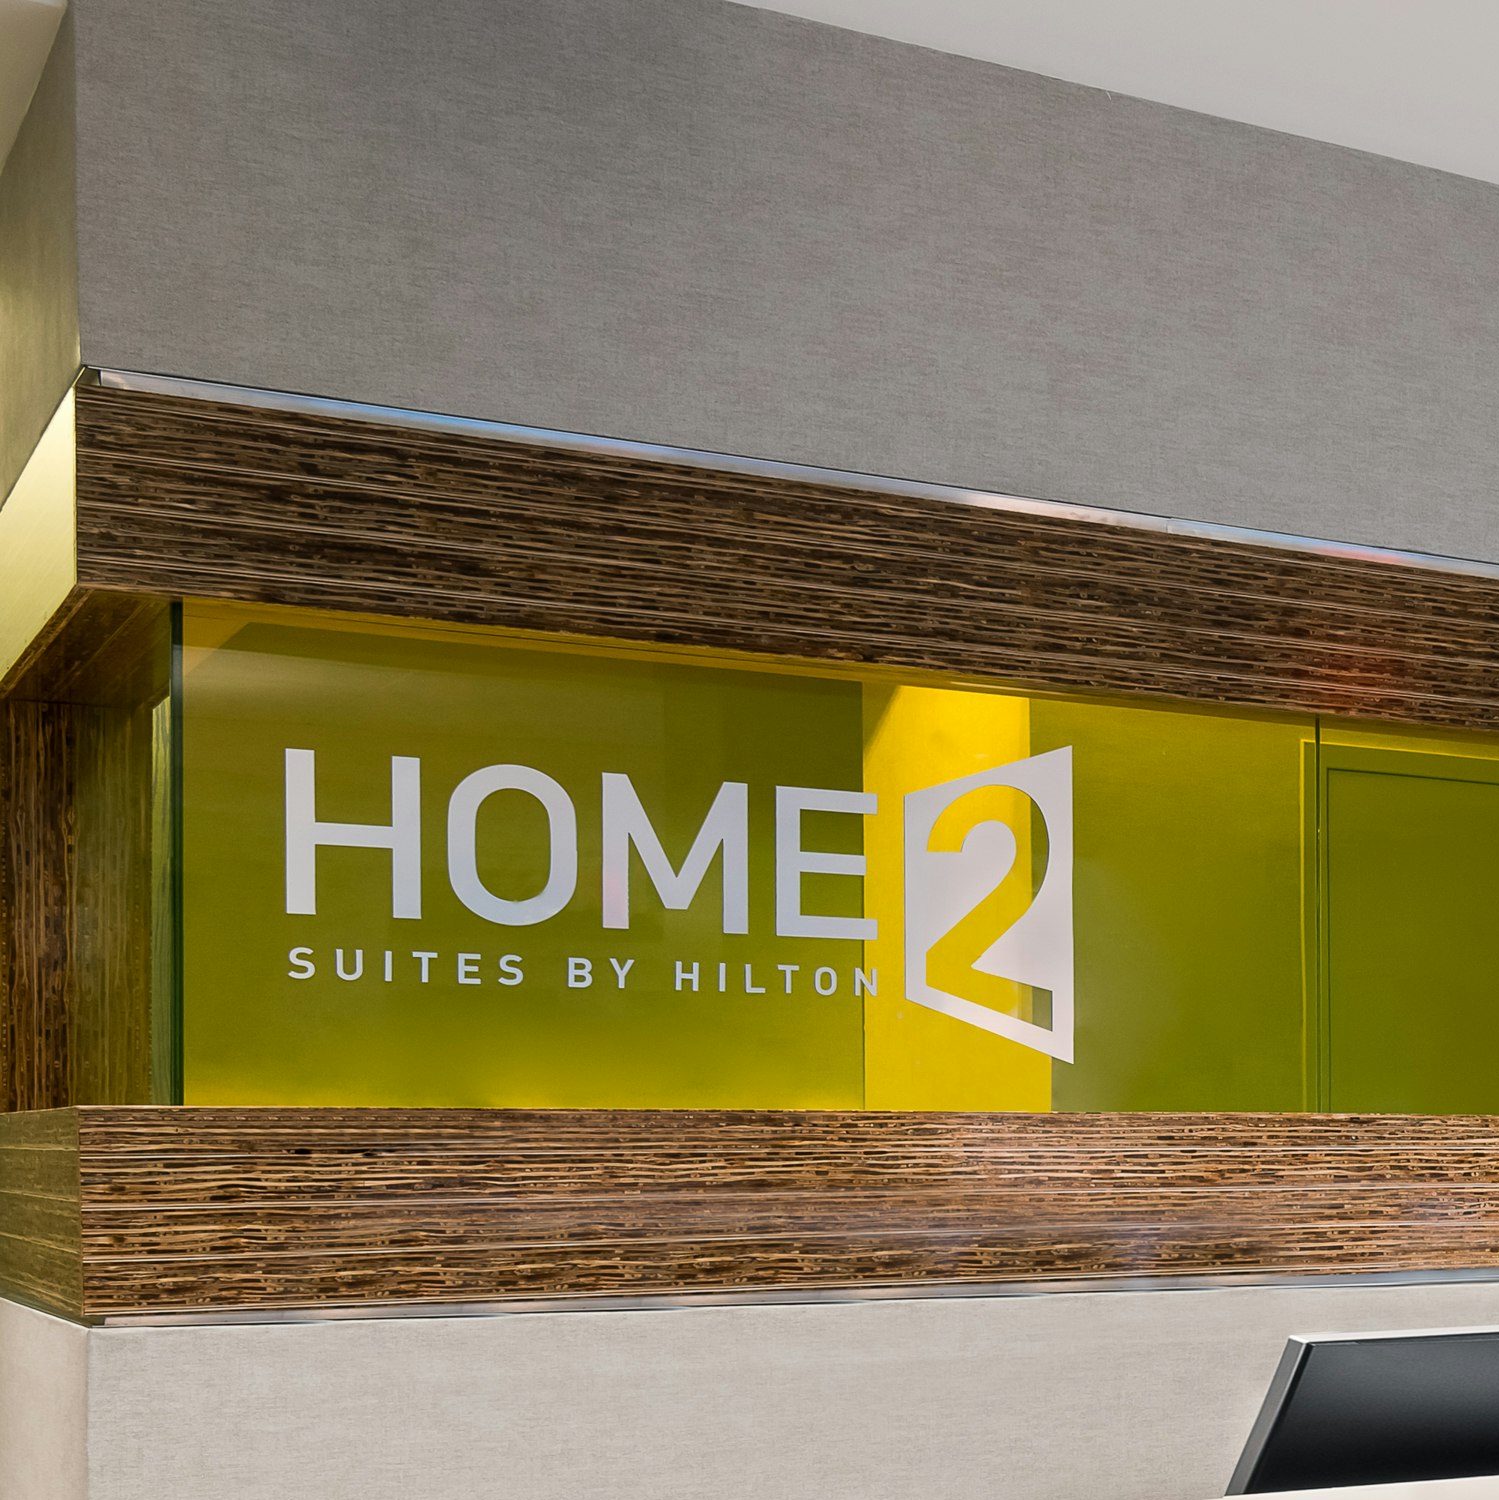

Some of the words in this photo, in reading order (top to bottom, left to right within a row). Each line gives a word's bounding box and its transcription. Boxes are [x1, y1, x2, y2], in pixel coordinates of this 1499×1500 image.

[287, 946, 525, 987] SUITES
[566, 957, 637, 990] BY
[674, 961, 878, 998] HILTON
